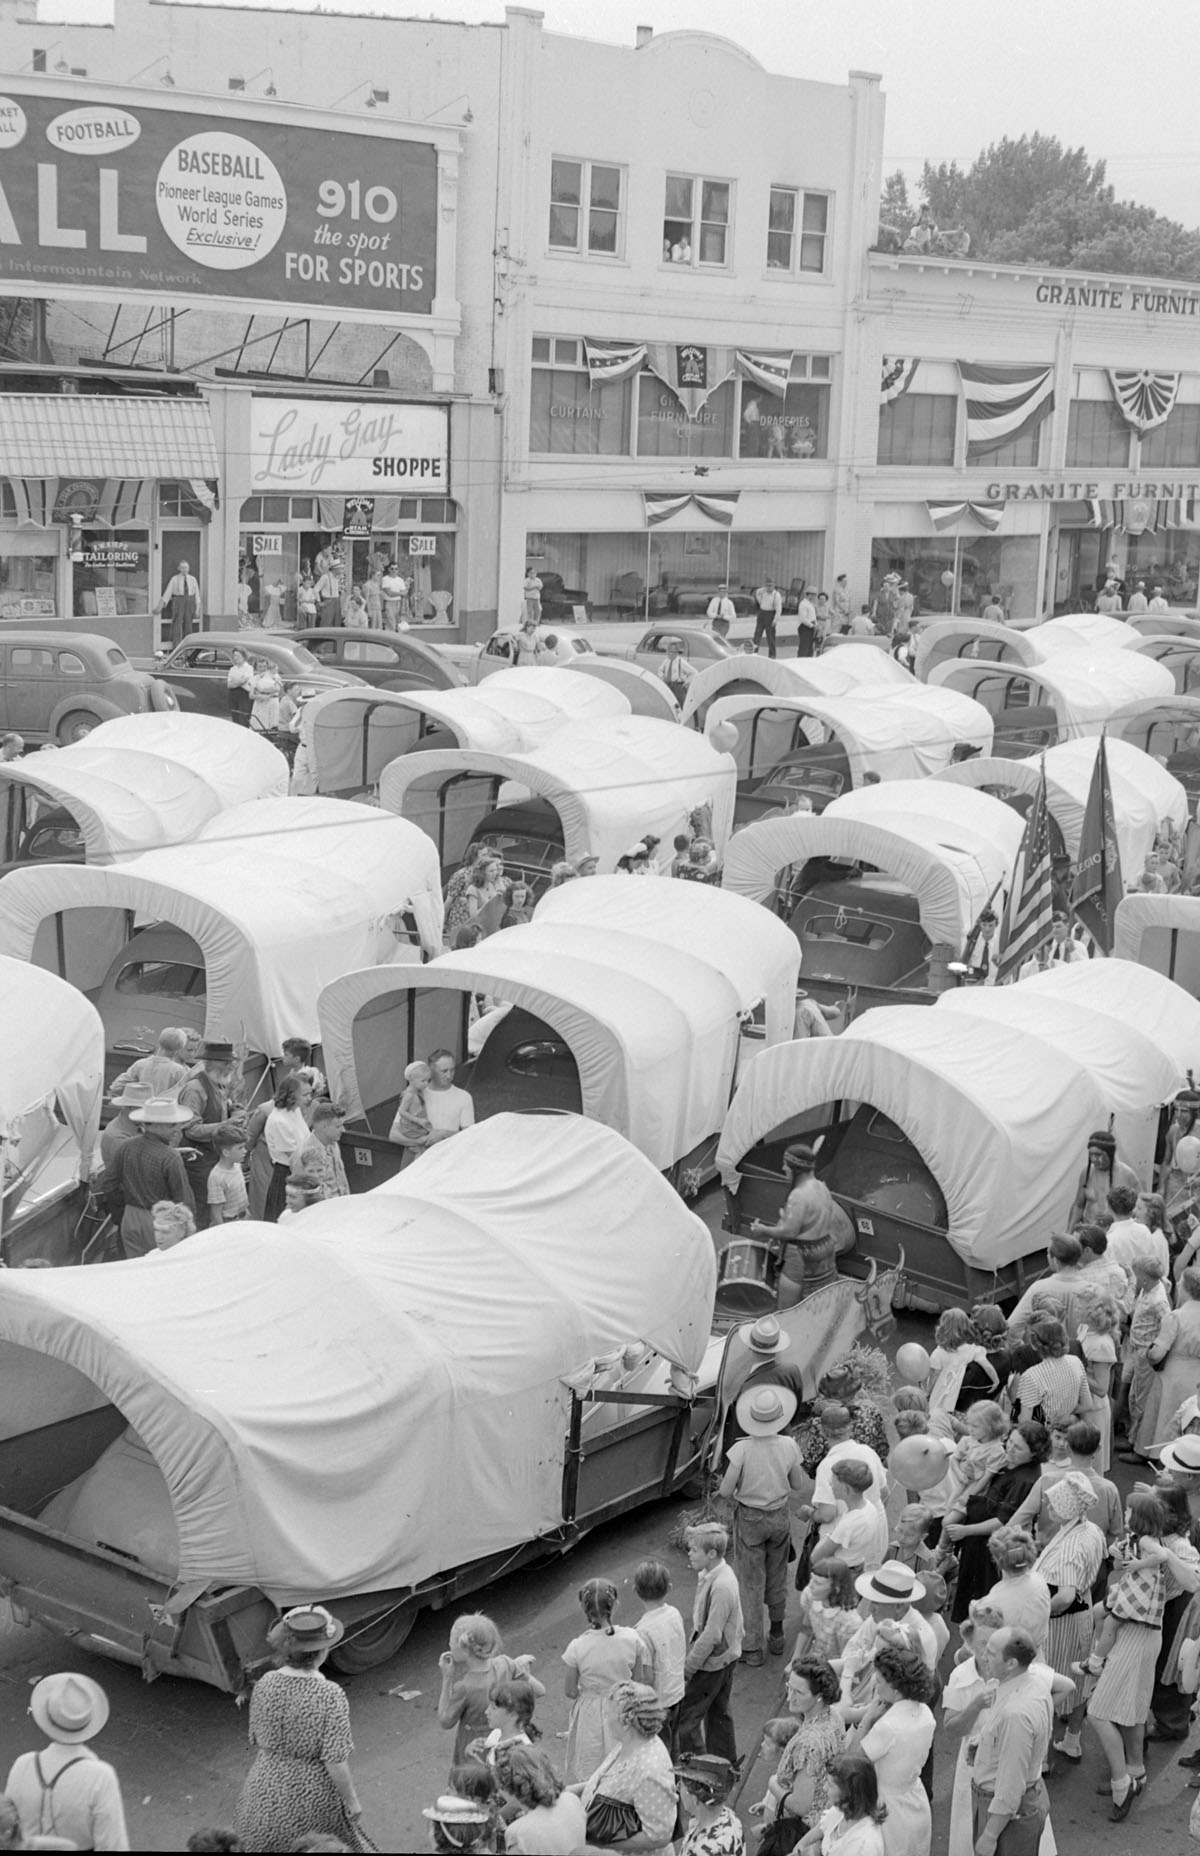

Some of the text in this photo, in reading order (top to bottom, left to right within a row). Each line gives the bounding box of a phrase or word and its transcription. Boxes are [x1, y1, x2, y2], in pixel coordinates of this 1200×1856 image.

[56, 120, 134, 142] FOOTBALL
[178, 148, 265, 180] BASEBALL
[158, 182, 284, 209] Pioneer League Games
[316, 179, 398, 223] 910
[178, 204, 264, 229] World Series
[186, 226, 262, 248] Exclusive!
[313, 224, 391, 256] the spot
[9, 259, 201, 284] Intermountain Network
[285, 252, 424, 291] FOR SPORTS
[1036, 284, 1123, 309] GRANITE
[550, 405, 608, 419] CURTAINS
[759, 415, 810, 428] DRAPERIES
[254, 407, 404, 486] Lady Gay
[372, 456, 442, 478] SHOPPE
[986, 483, 1099, 499] GRANITE
[254, 536, 280, 553] SALE
[410, 537, 435, 553] SALE
[84, 552, 139, 561] TAILORING
